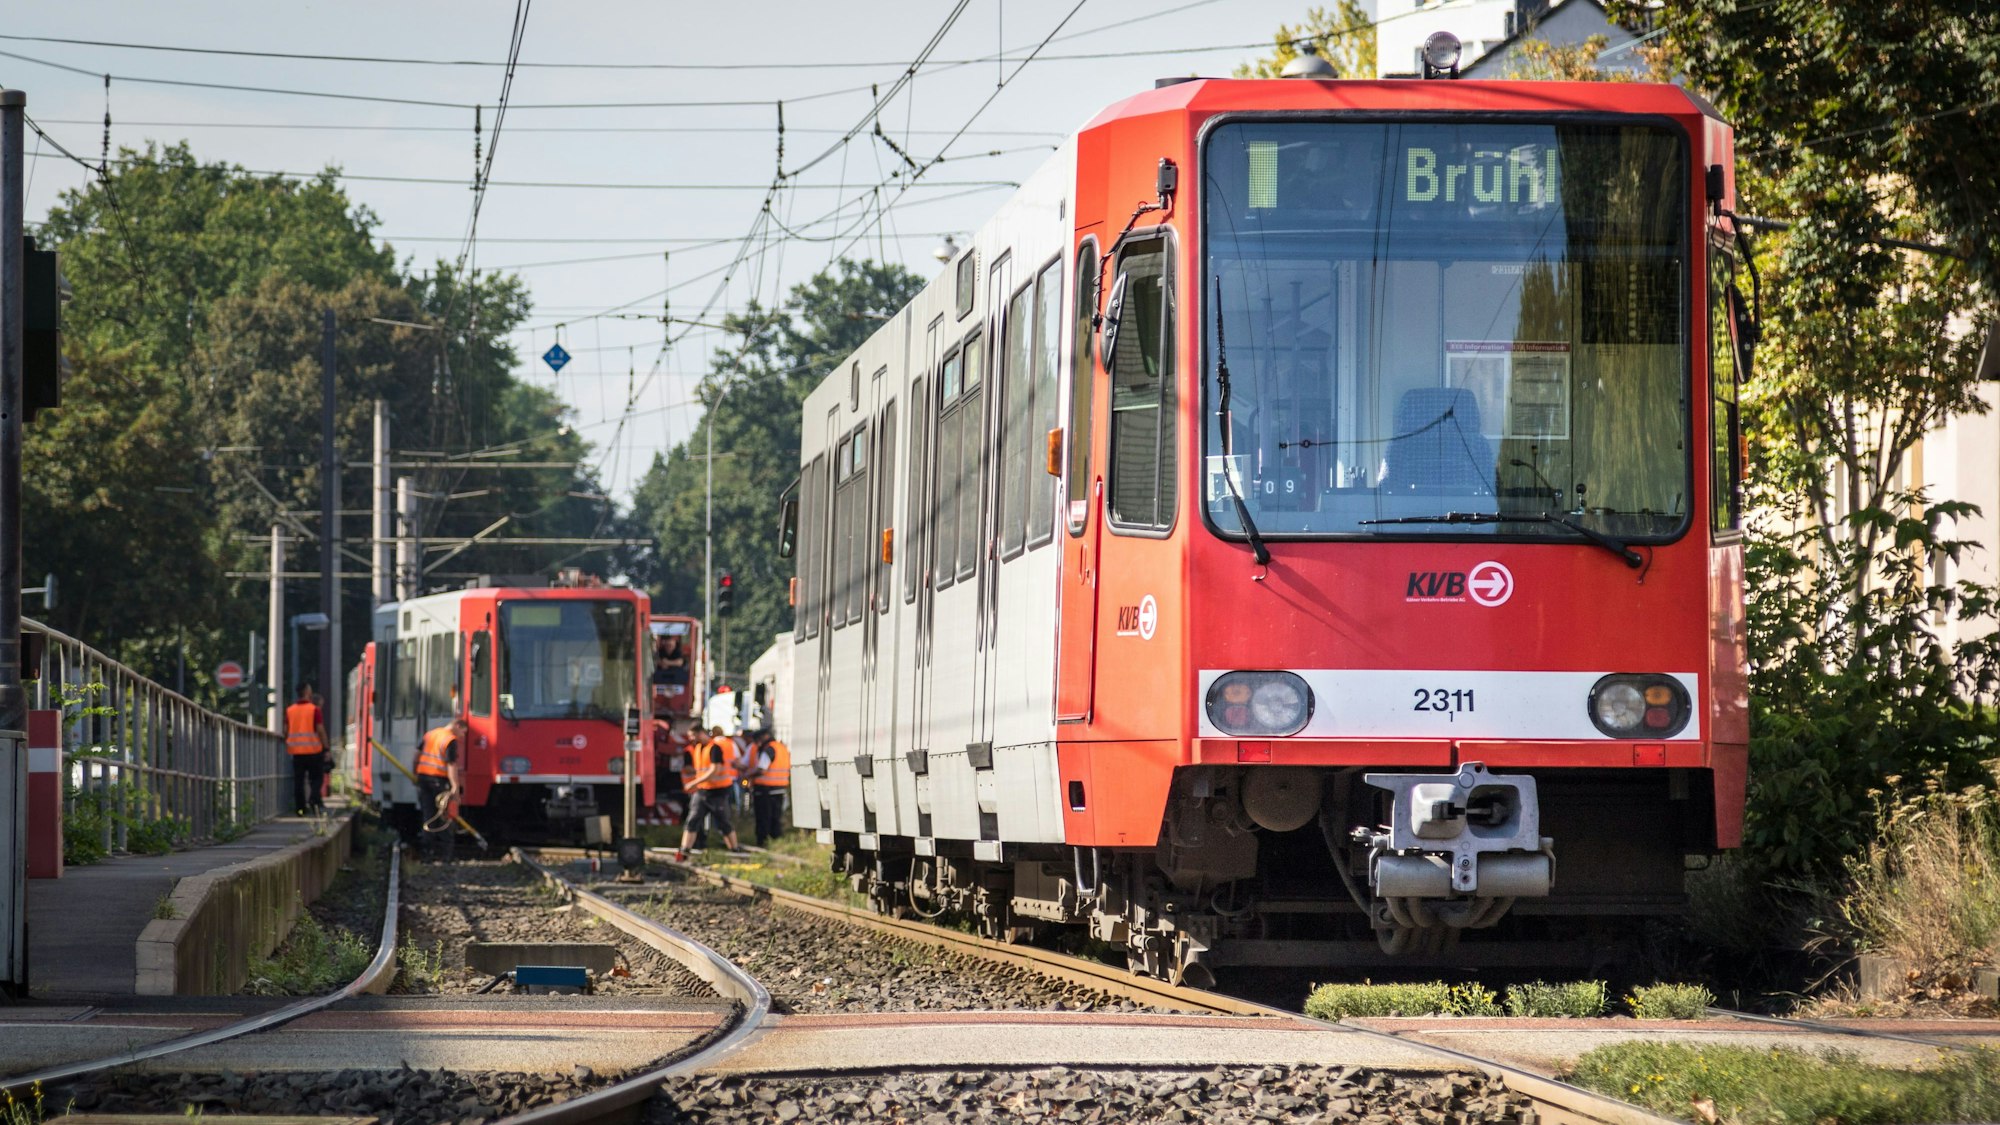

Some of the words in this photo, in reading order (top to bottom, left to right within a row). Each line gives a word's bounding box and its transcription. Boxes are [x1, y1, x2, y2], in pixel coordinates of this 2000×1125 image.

[1407, 147, 1556, 203] Brühl
[1406, 572, 1467, 597] KVB
[1118, 606, 1140, 630] KVB
[1414, 688, 1474, 711] 2311
[1448, 710, 1454, 722] 1
